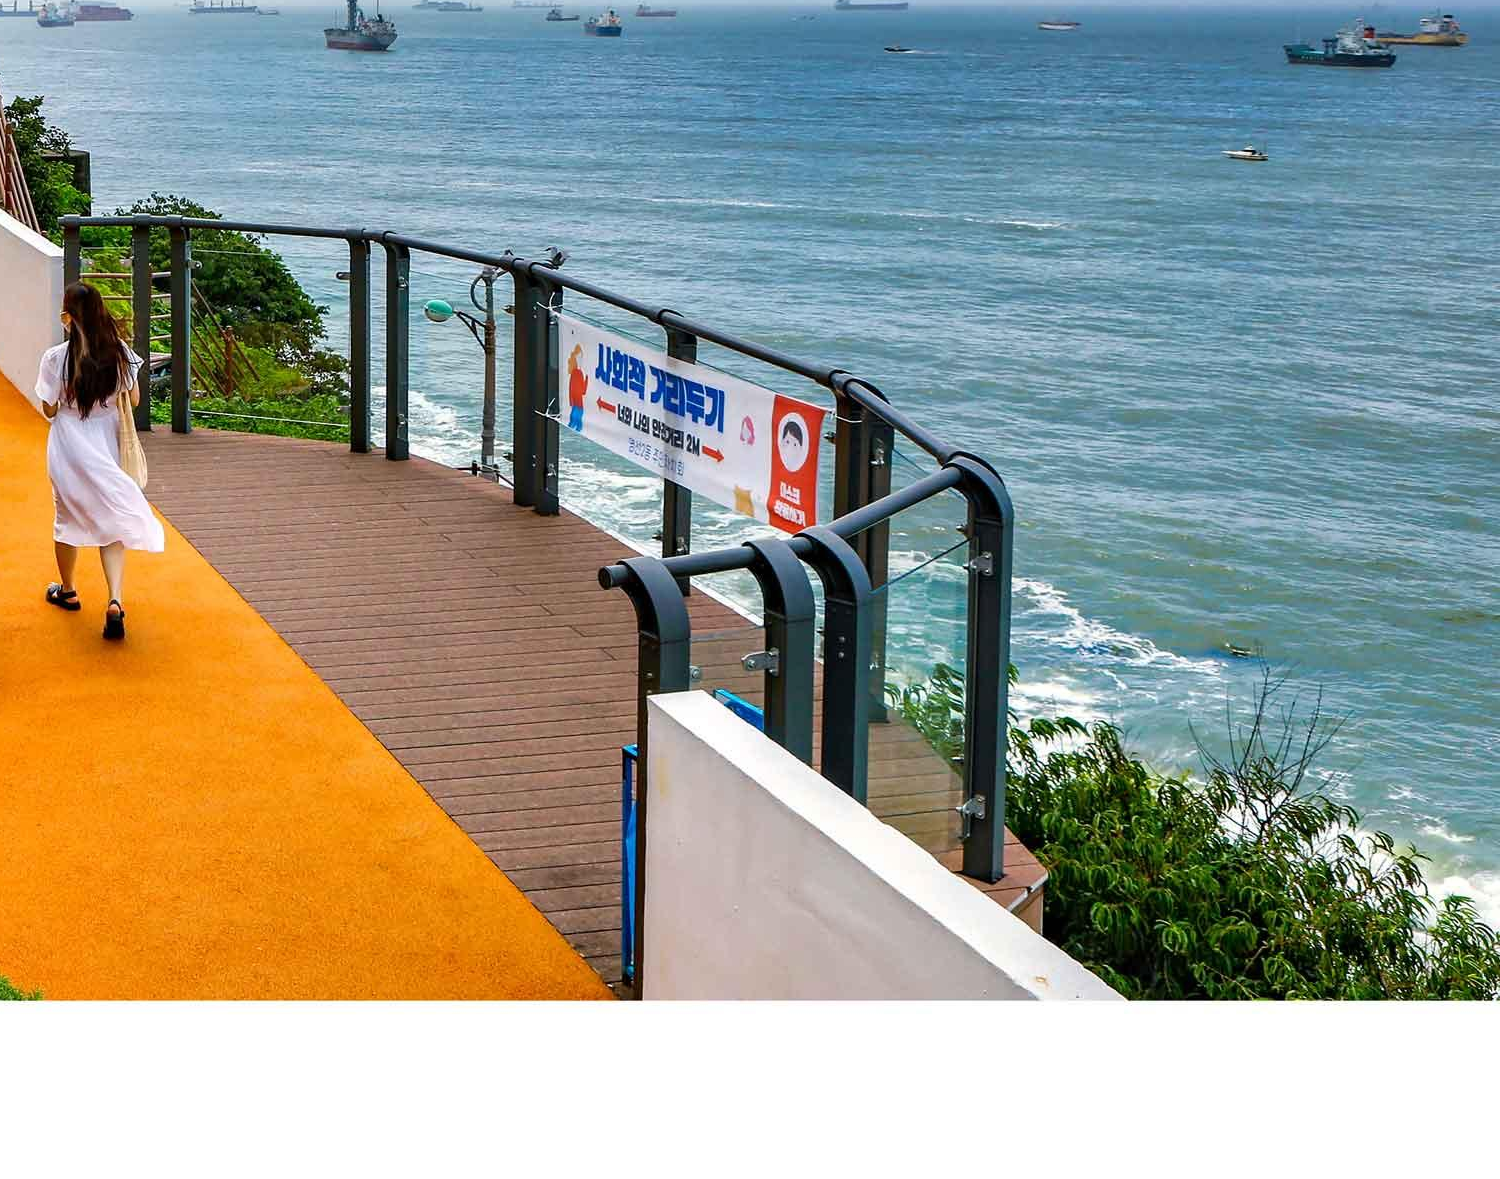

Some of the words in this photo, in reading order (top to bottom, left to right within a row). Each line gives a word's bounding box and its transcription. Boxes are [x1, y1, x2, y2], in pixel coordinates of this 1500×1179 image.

[595, 342, 646, 403] 사회적
[649, 365, 725, 434] 거리두기
[617, 403, 632, 427] 너와
[633, 411, 650, 434] 나의
[652, 419, 685, 449] 안전거리
[686, 433, 701, 456] 2M
